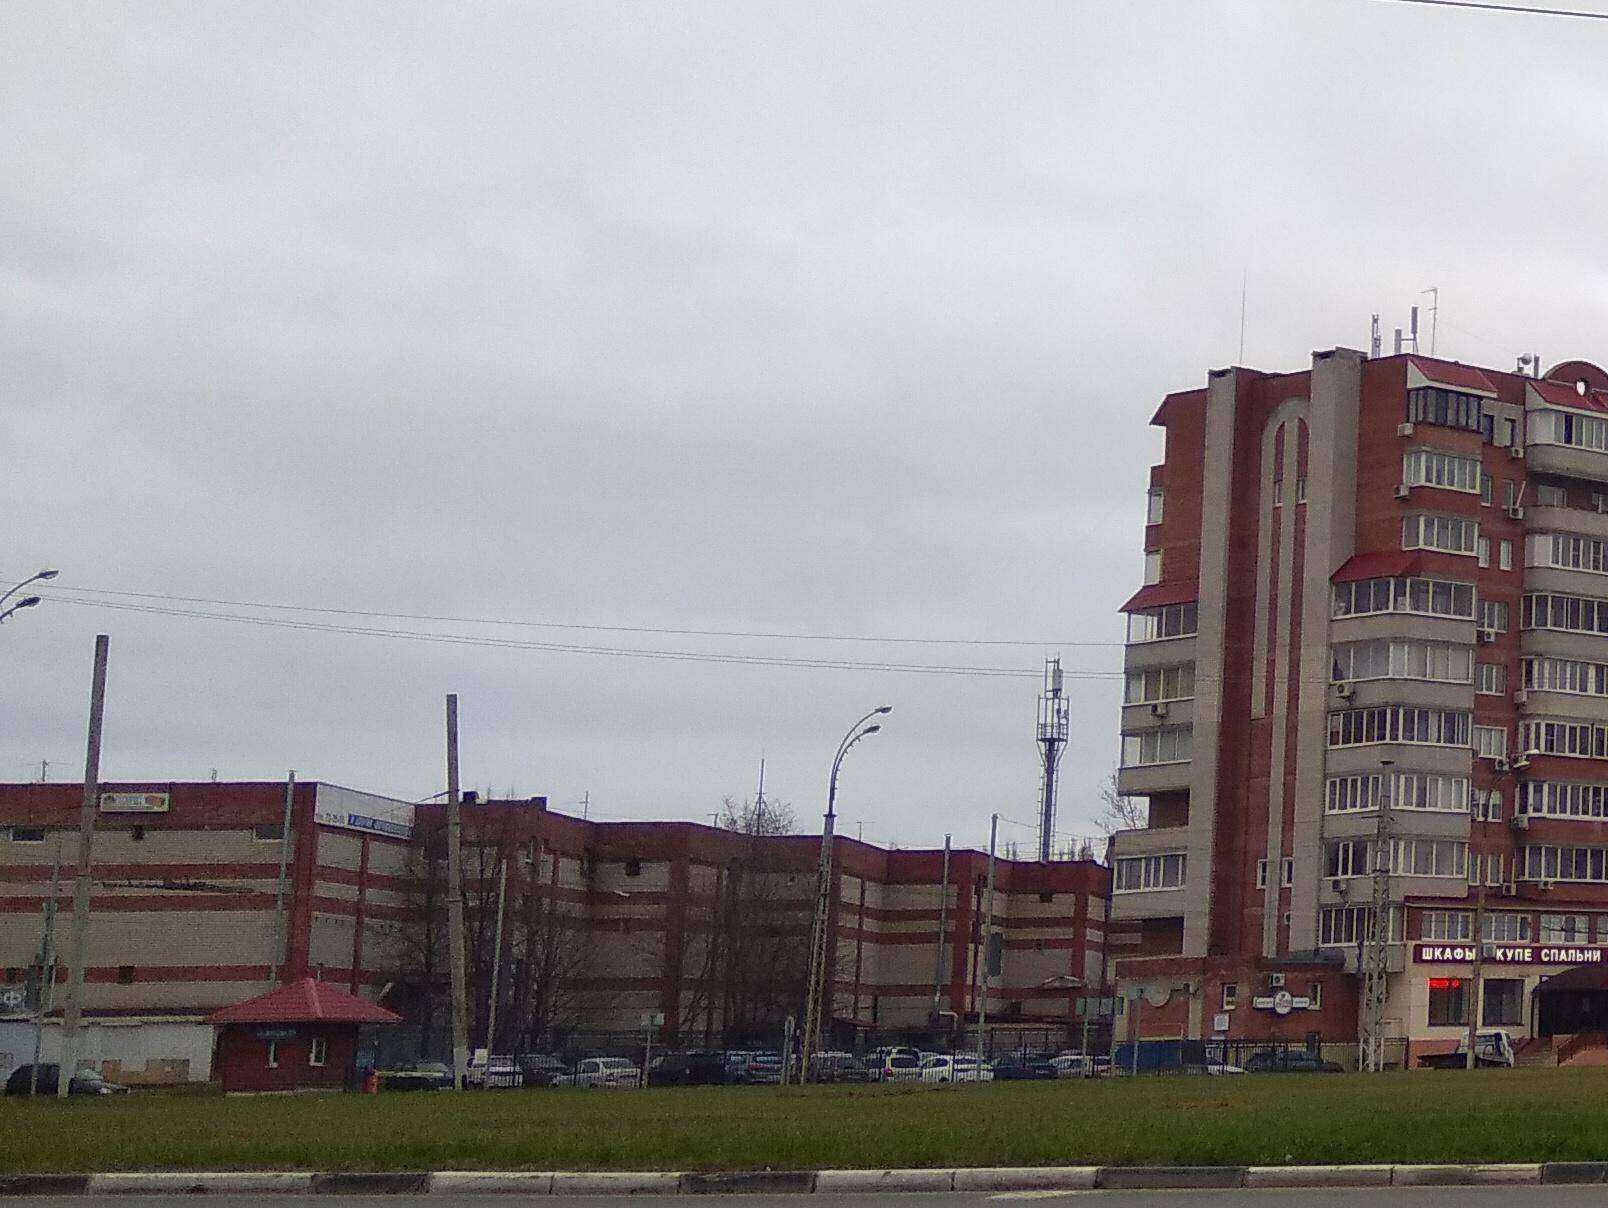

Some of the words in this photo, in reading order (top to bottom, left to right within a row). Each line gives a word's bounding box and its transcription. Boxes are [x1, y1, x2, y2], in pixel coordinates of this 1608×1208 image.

[1421, 947, 1476, 960] ШКАФЫ
[1496, 948, 1533, 962] КУПЕ
[1541, 949, 1601, 963] СПАЛЬНИ
